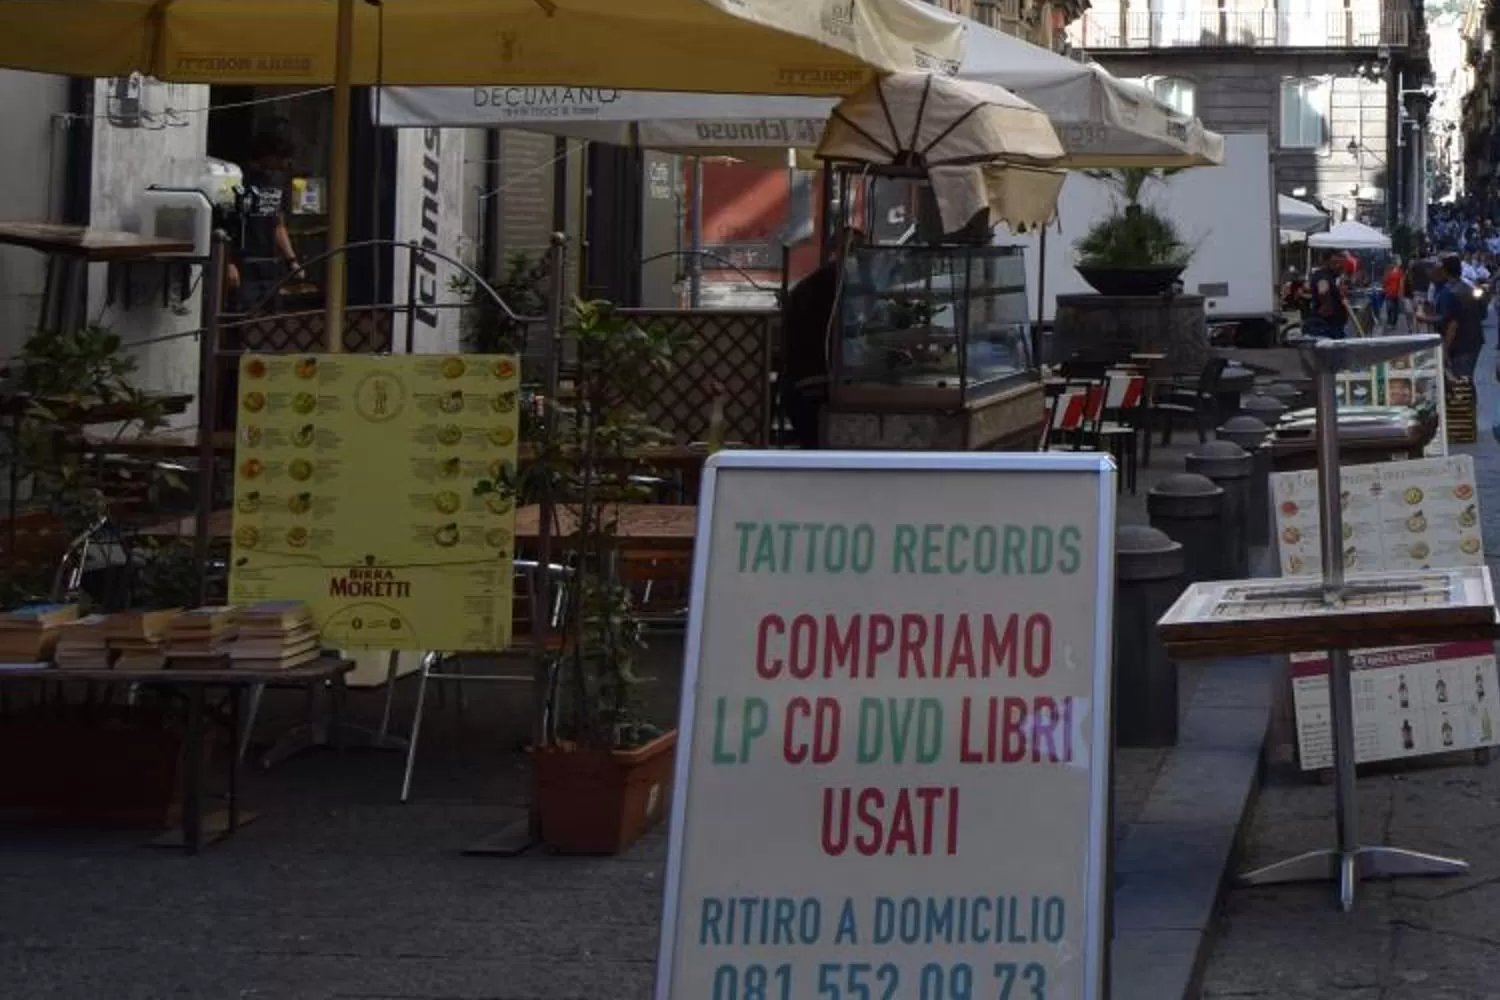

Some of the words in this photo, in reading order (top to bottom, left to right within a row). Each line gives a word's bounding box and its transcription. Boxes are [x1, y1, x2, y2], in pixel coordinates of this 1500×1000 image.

[473, 87, 618, 108] DECUMANO
[415, 127, 441, 329] Ichnus
[735, 521, 875, 574] TATTOO
[893, 522, 1084, 575] RECORDS
[330, 577, 411, 597] MORETTI
[755, 612, 1053, 680] COMPRIAMO
[711, 697, 769, 765] LP
[782, 696, 842, 765] CD
[856, 697, 944, 765] DVD
[959, 695, 1074, 765] LIBRI
[820, 786, 960, 857] USATI
[699, 897, 822, 946] RITIRO
[835, 899, 859, 945] A
[873, 896, 1066, 946] DOMICILIO
[713, 963, 793, 1000] 081
[818, 963, 900, 1000] 552
[993, 963, 1047, 1000] 73
